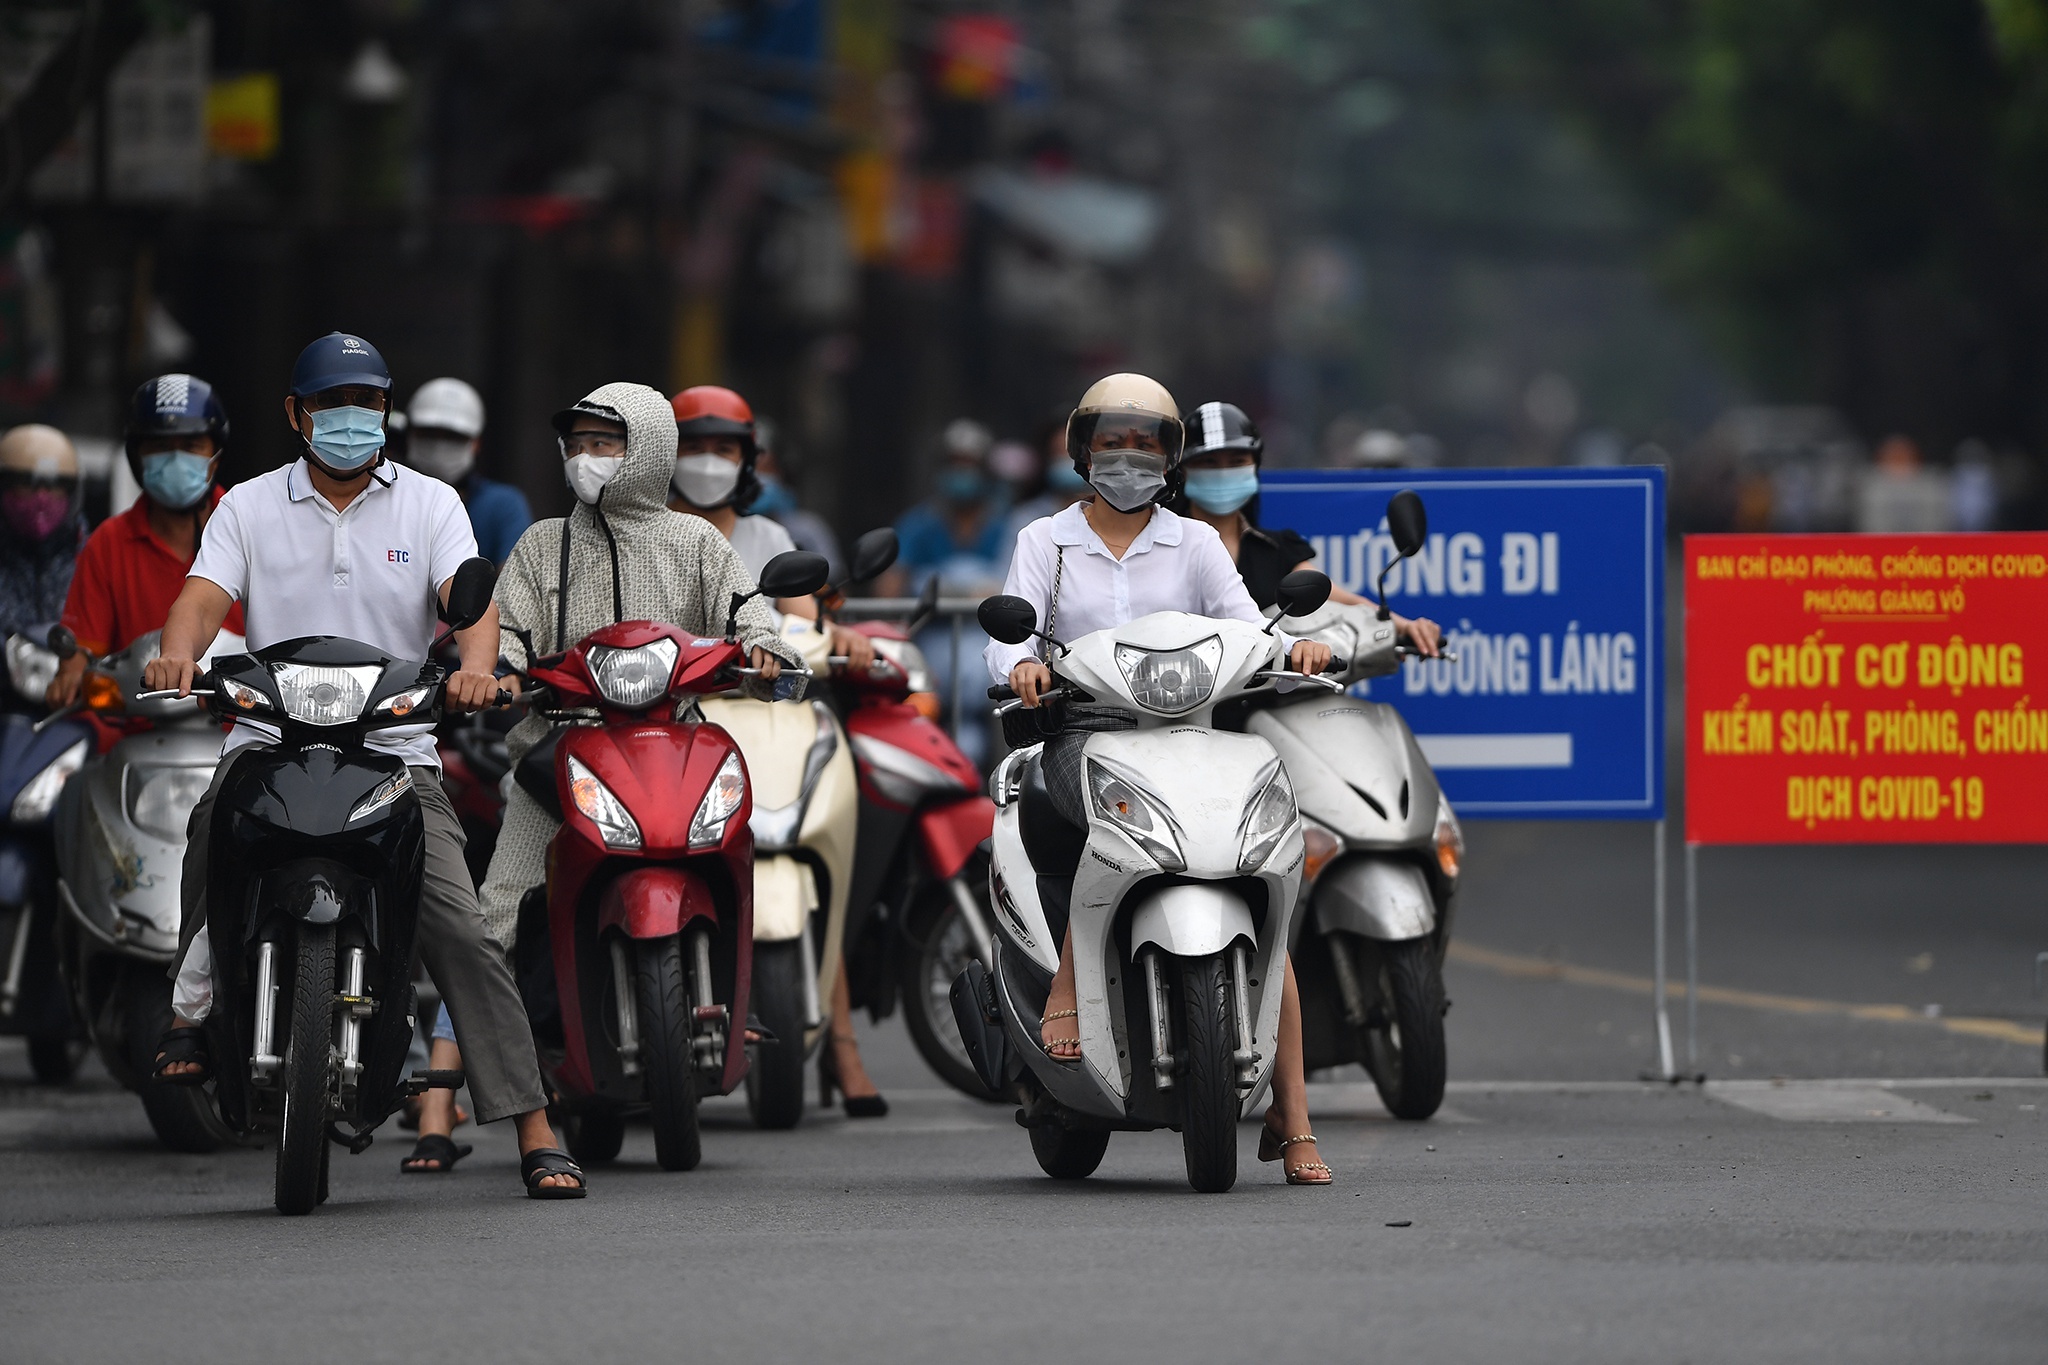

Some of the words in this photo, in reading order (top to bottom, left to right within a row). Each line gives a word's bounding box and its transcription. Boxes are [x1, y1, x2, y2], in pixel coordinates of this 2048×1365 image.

[387, 549, 409, 563] ETC
[1500, 530, 1560, 596] ĐI
[1697, 555, 1736, 580] BAN
[1946, 555, 1989, 584] DỊCH
[1402, 617, 1531, 696] ĐƯỜNG
[1539, 620, 1637, 695] LÁNG
[1746, 629, 1845, 688] CHỐT
[1855, 641, 1910, 688] CƠ
[1917, 634, 2024, 697] ĐỘNG
[300, 743, 343, 754] HONDA
[1170, 728, 1209, 736] HONDA
[1779, 701, 1859, 759] SOÁT,
[1865, 700, 1967, 759] PHÒNG,
[1787, 775, 1852, 830] DỊCH
[1859, 775, 1984, 821] COVID-19
[1091, 850, 1123, 873] HONDA
